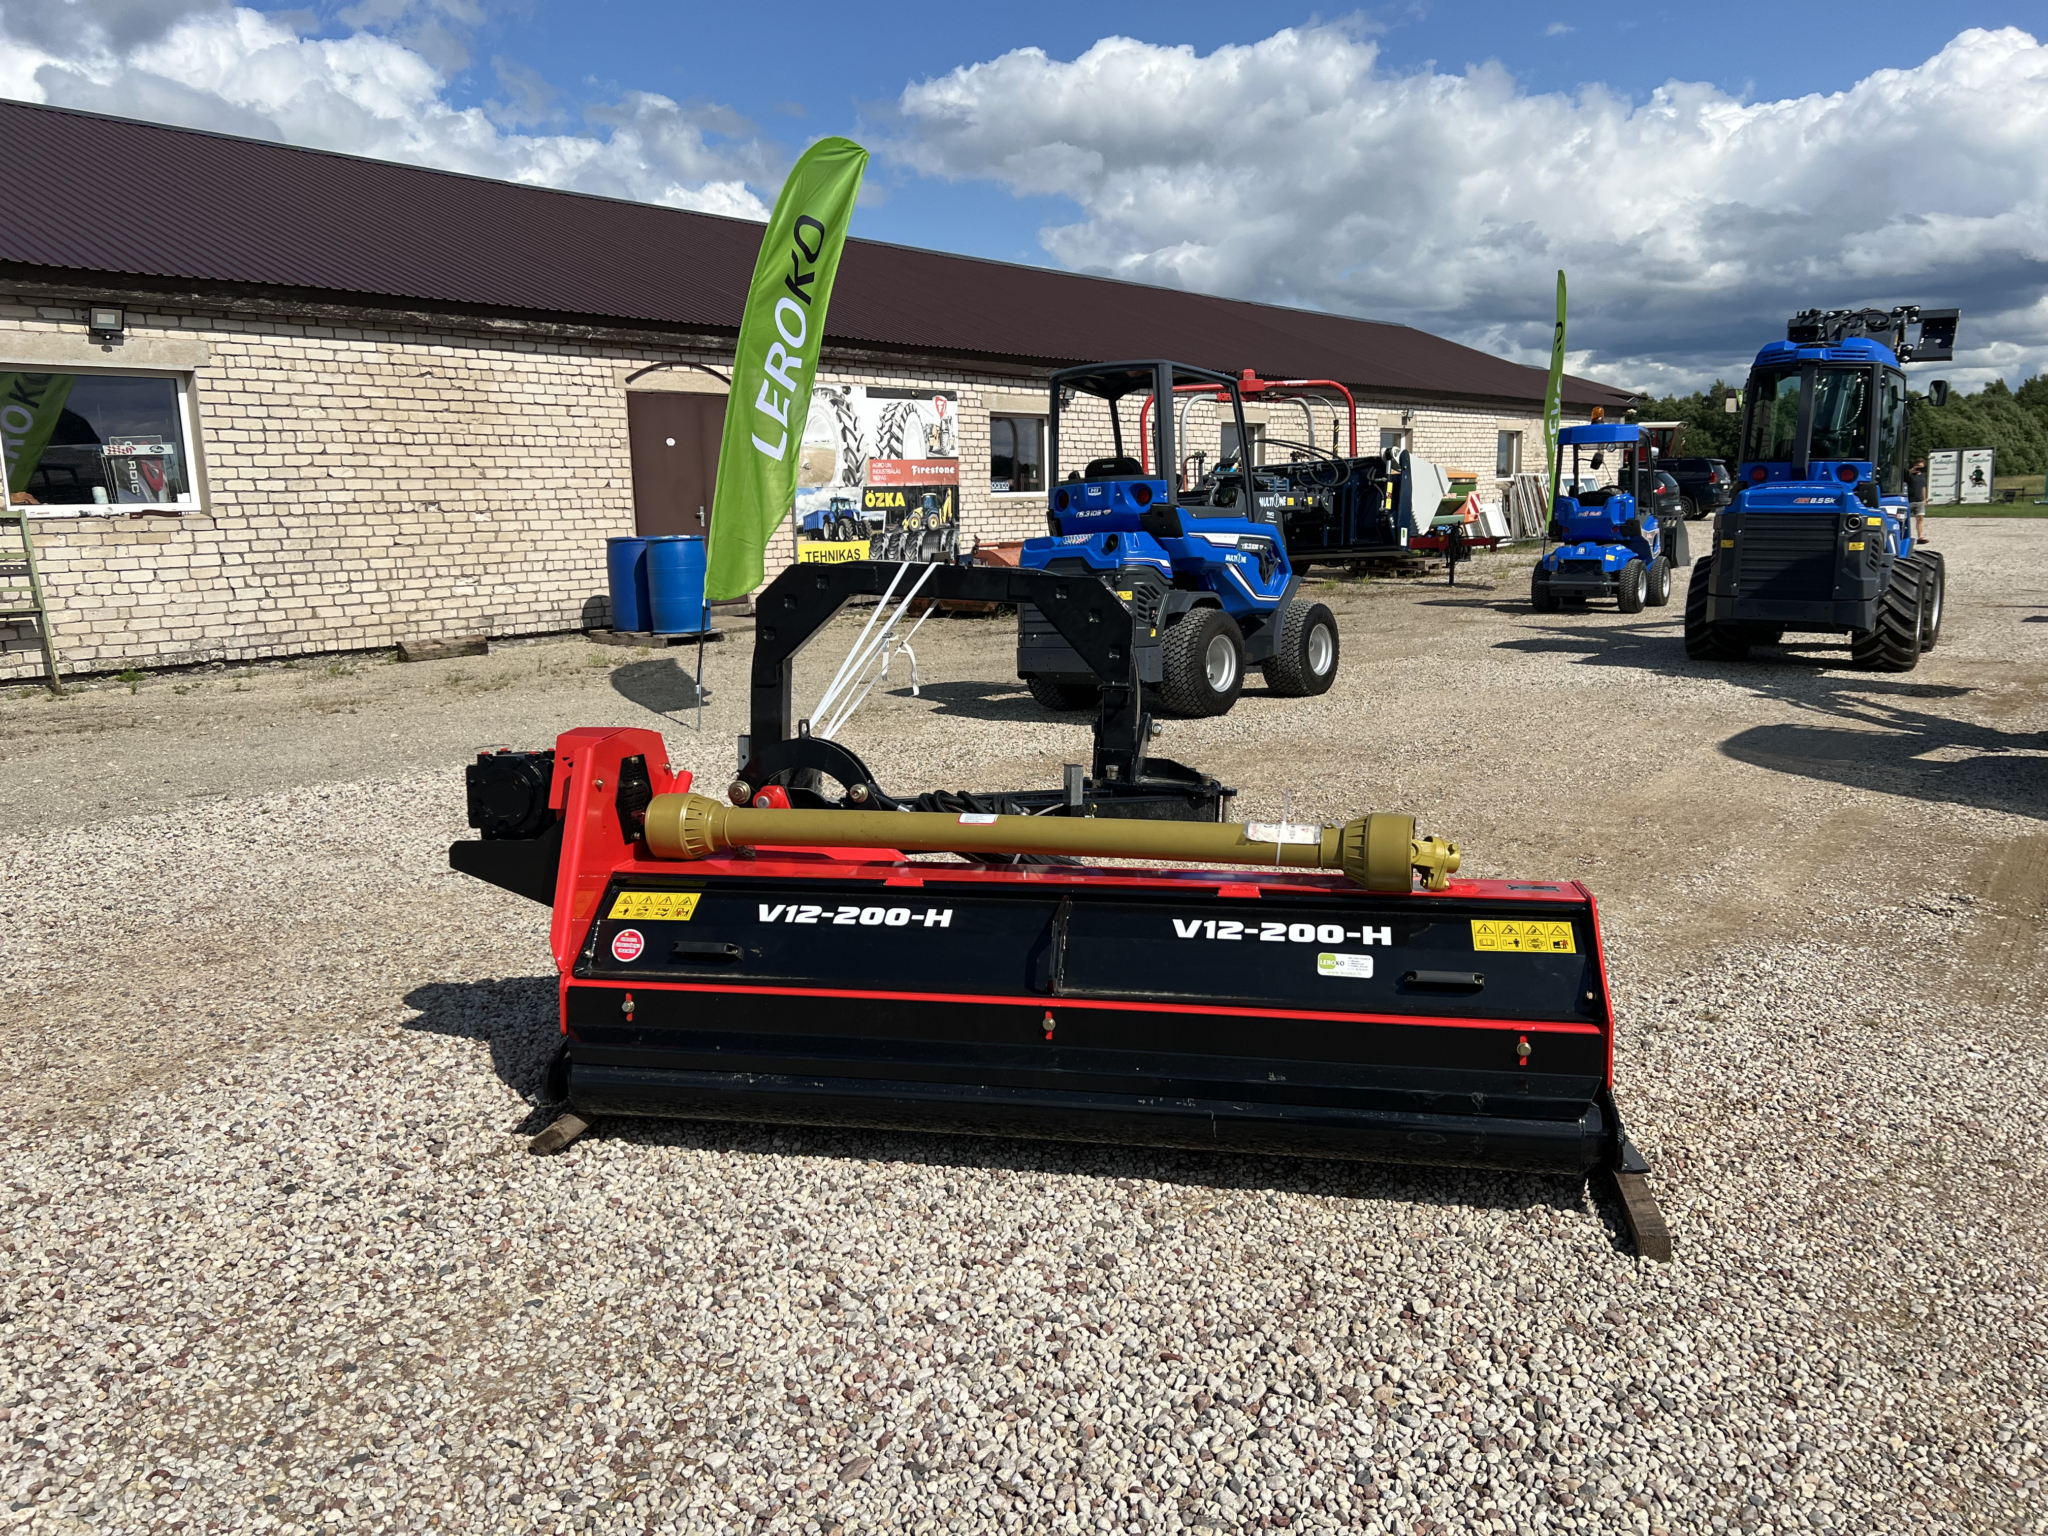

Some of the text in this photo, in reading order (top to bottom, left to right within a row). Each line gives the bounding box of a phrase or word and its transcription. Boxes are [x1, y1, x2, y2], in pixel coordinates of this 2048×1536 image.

[752, 214, 825, 462] LEROKO
[911, 465, 955, 476] Firestone
[865, 490, 906, 508] ÖZKA
[805, 548, 861, 564] TEHNIKAS
[758, 903, 954, 928] V12-200-H
[1172, 918, 1393, 946] V12-200-H
[1320, 959, 1345, 967] LEROKO
